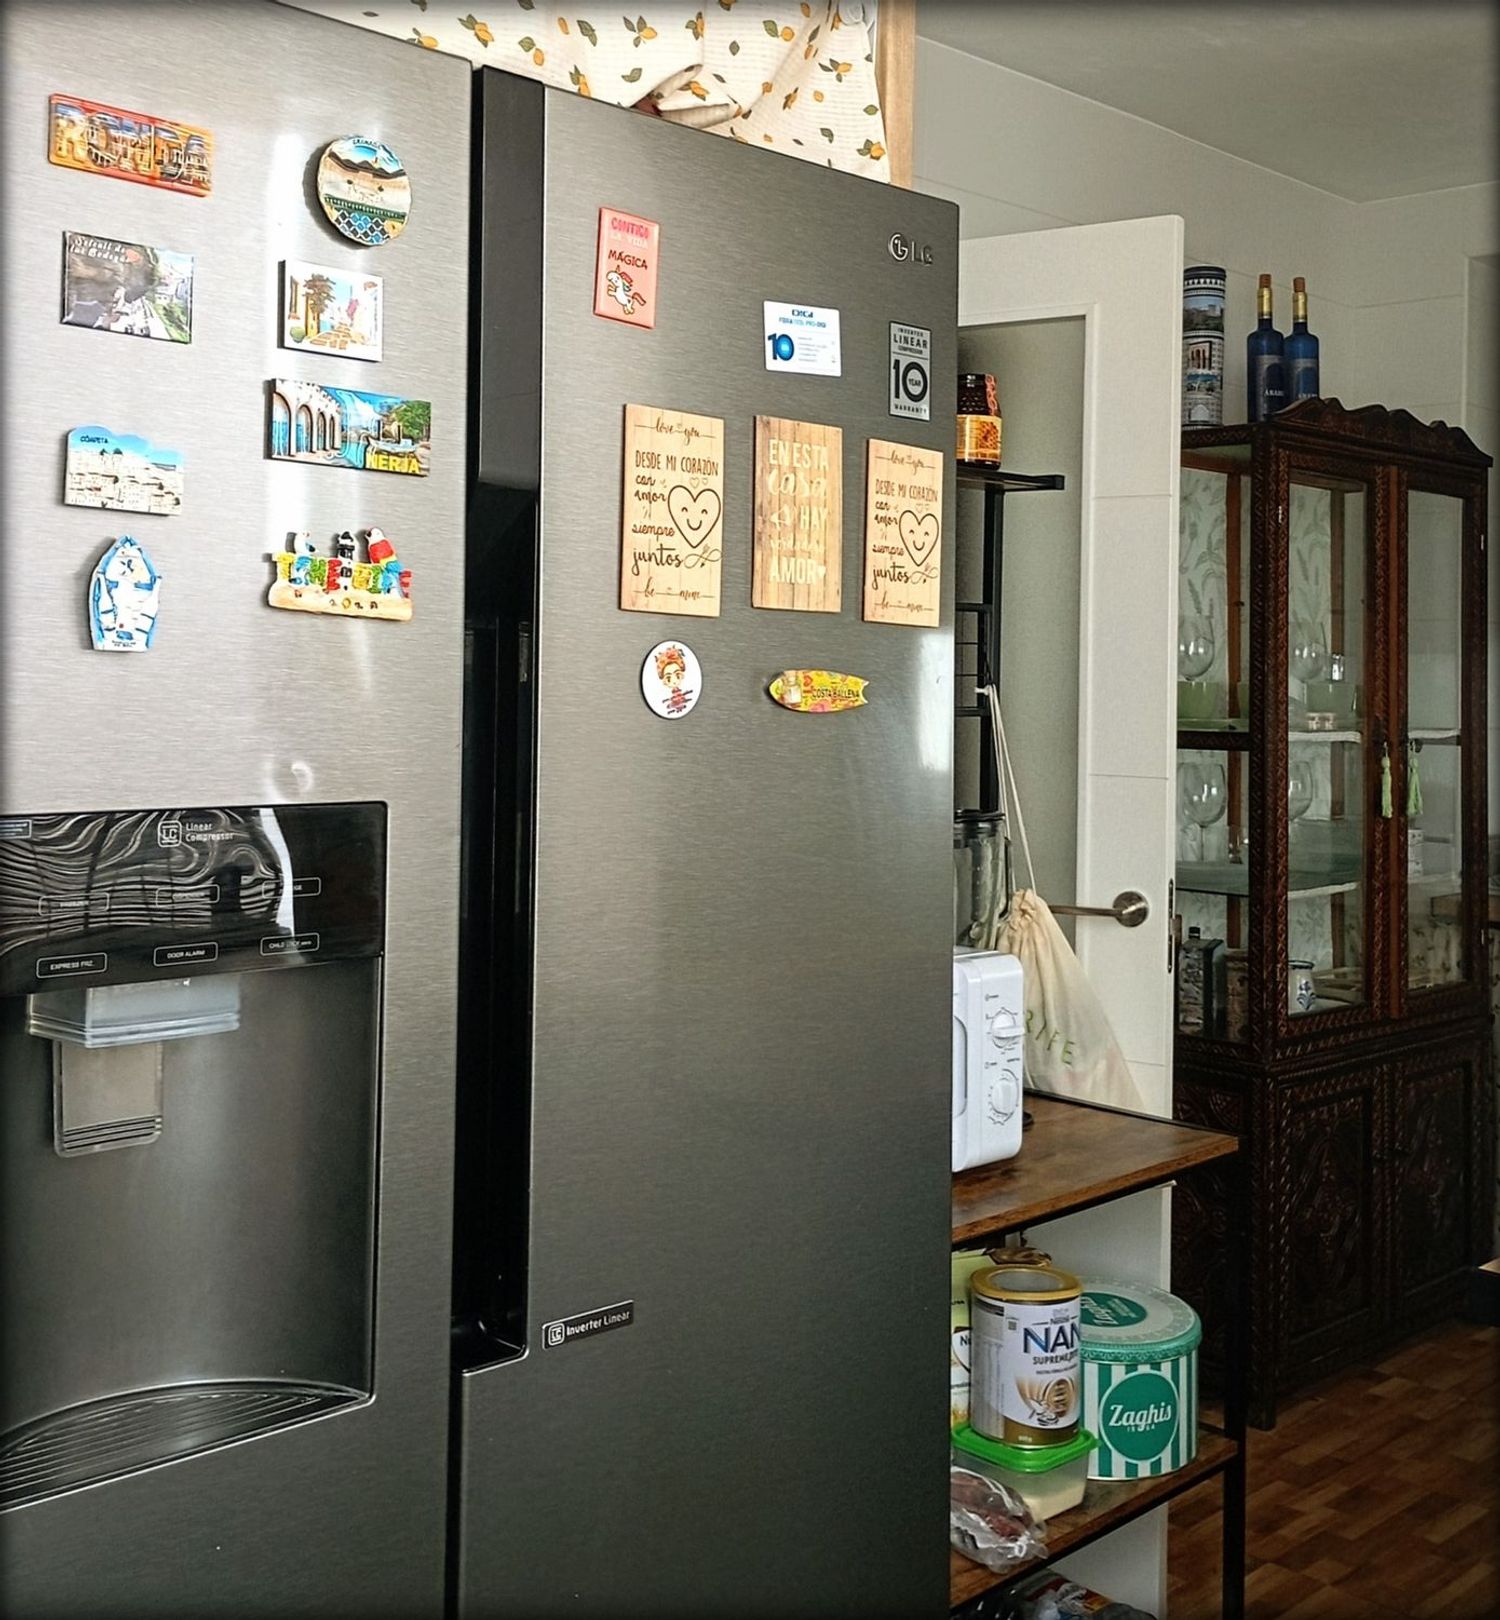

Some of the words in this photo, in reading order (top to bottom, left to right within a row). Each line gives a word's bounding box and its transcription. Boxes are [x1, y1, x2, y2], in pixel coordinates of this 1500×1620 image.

[611, 217, 650, 239] CONTIGO
[608, 249, 648, 270] MÁGICA
[767, 332, 795, 361] 10
[893, 333, 928, 349] LINEAR
[893, 358, 928, 402] 10
[894, 403, 927, 415] WARRANTY
[365, 452, 420, 474] NERJA
[635, 449, 661, 470] DESDE
[666, 454, 677, 472] MI
[680, 456, 719, 476] CORAZÓN
[768, 438, 790, 467] EN
[792, 441, 829, 471] ESTA
[875, 479, 896, 497] DESDE
[898, 483, 906, 498] MI
[800, 505, 829, 531] HAY
[631, 523, 676, 542] siempre
[631, 543, 683, 576] juntos
[769, 556, 817, 585] AMOR
[872, 562, 910, 591] juntos
[185, 822, 213, 832] Linear
[185, 832, 234, 842] Compressor
[167, 951, 184, 959] DOOR
[185, 949, 206, 957] ALARM
[566, 1318, 602, 1336] Inverter
[603, 1311, 630, 1326] Linear
[1108, 1401, 1172, 1432] Zaghis
